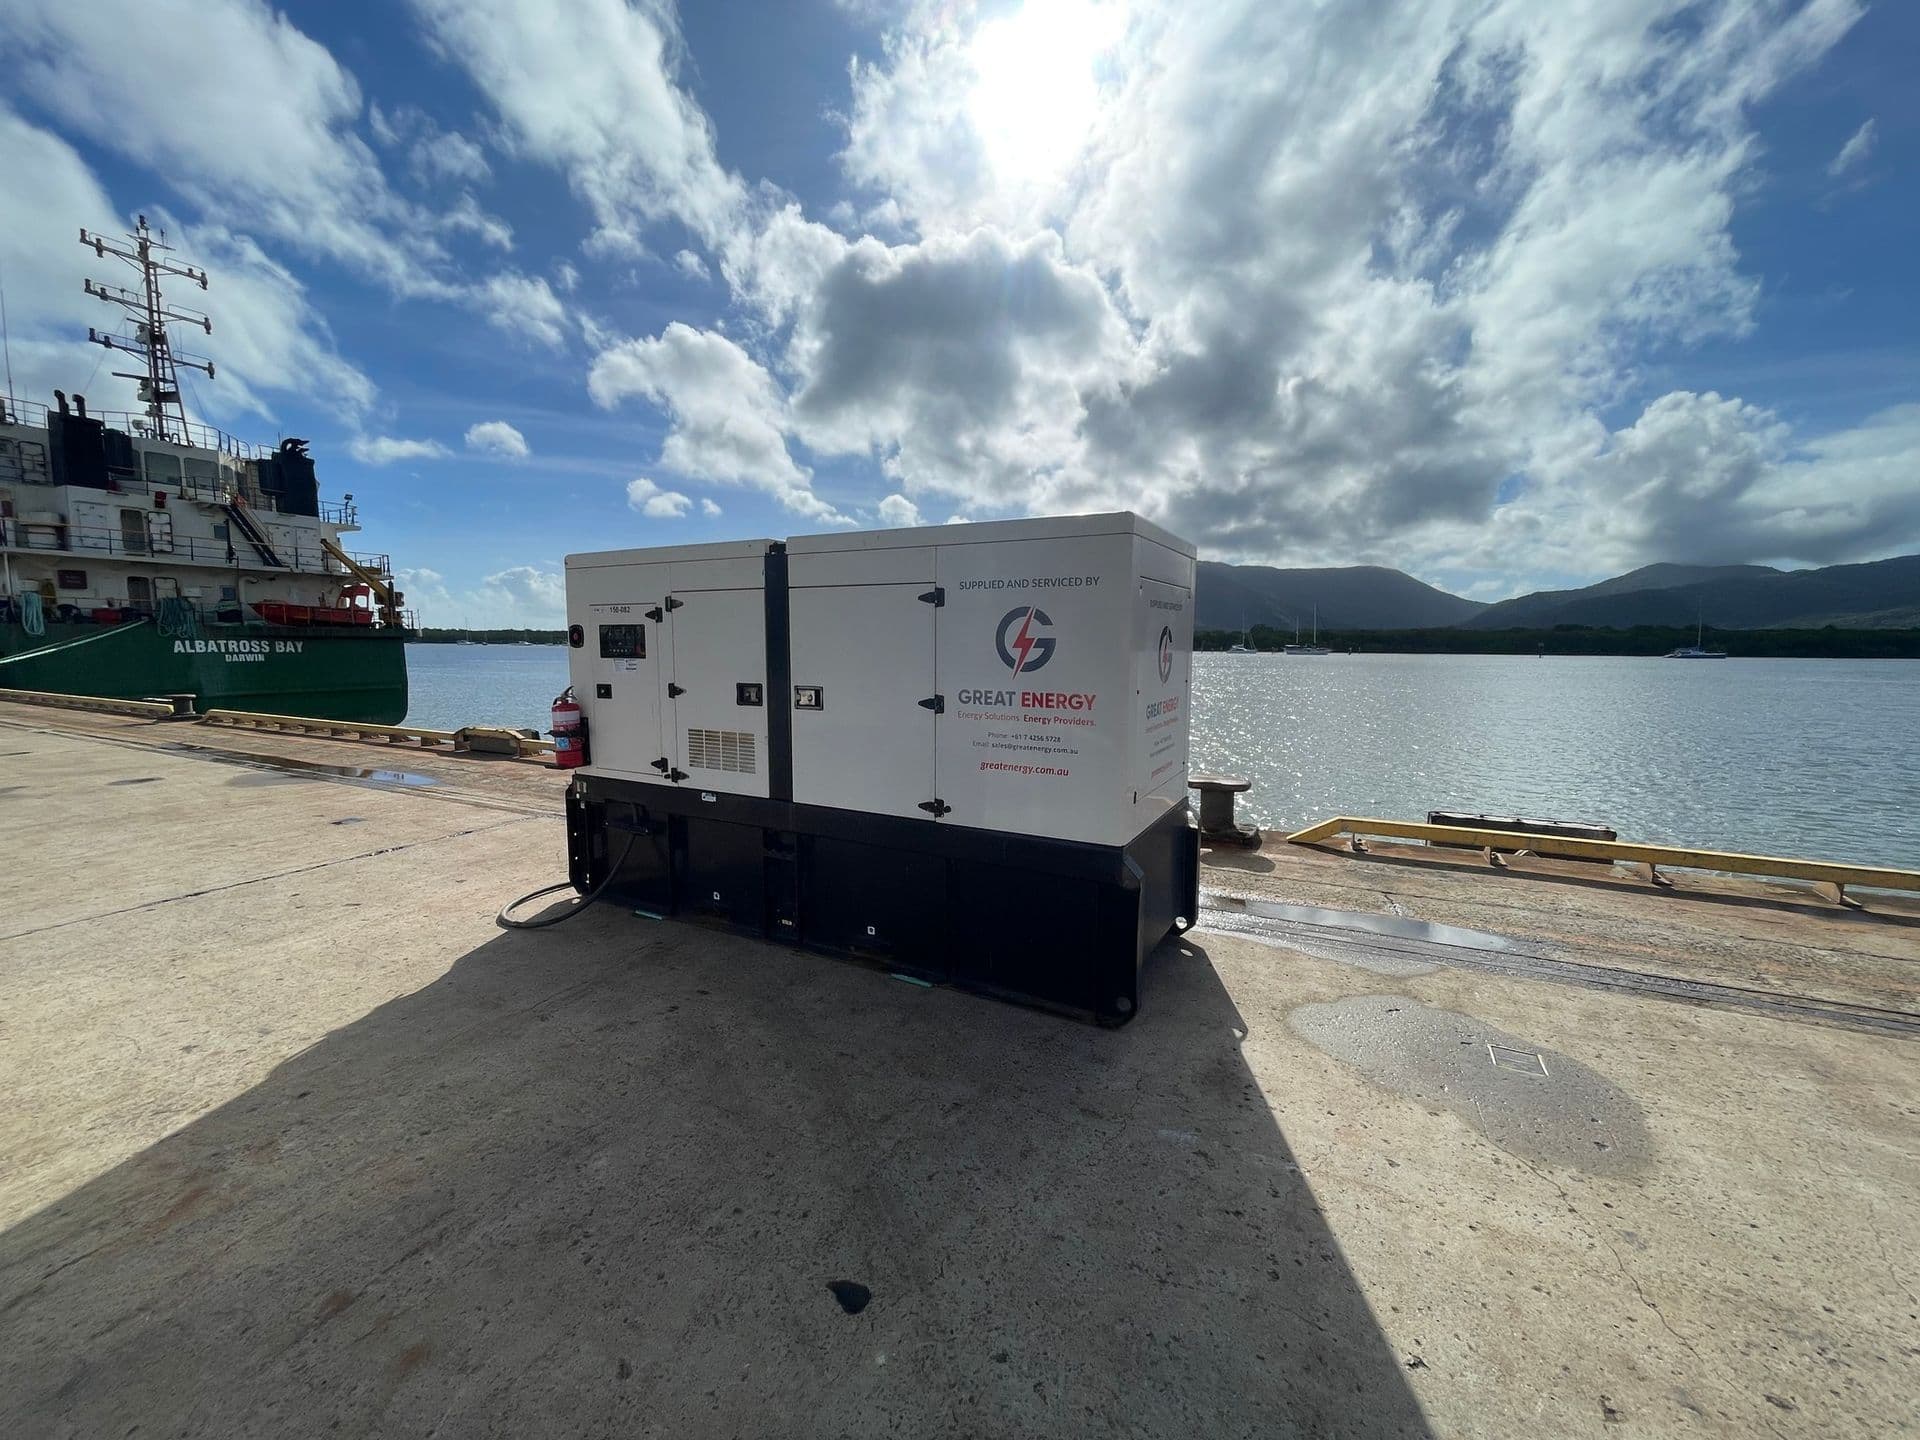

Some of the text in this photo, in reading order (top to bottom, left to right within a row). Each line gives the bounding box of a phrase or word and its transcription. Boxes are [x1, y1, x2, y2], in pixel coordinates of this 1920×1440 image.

[959, 576, 1100, 591] SUPPLIED AND SERVICED BY
[173, 640, 304, 653] ALBATROSS BAY
[225, 654, 265, 663] DARWIN
[958, 689, 1097, 711] GREAT ENERGY
[957, 710, 983, 721] Energy
[1023, 714, 1052, 726] Energy
[980, 760, 1070, 777] greatenergy.com.au
